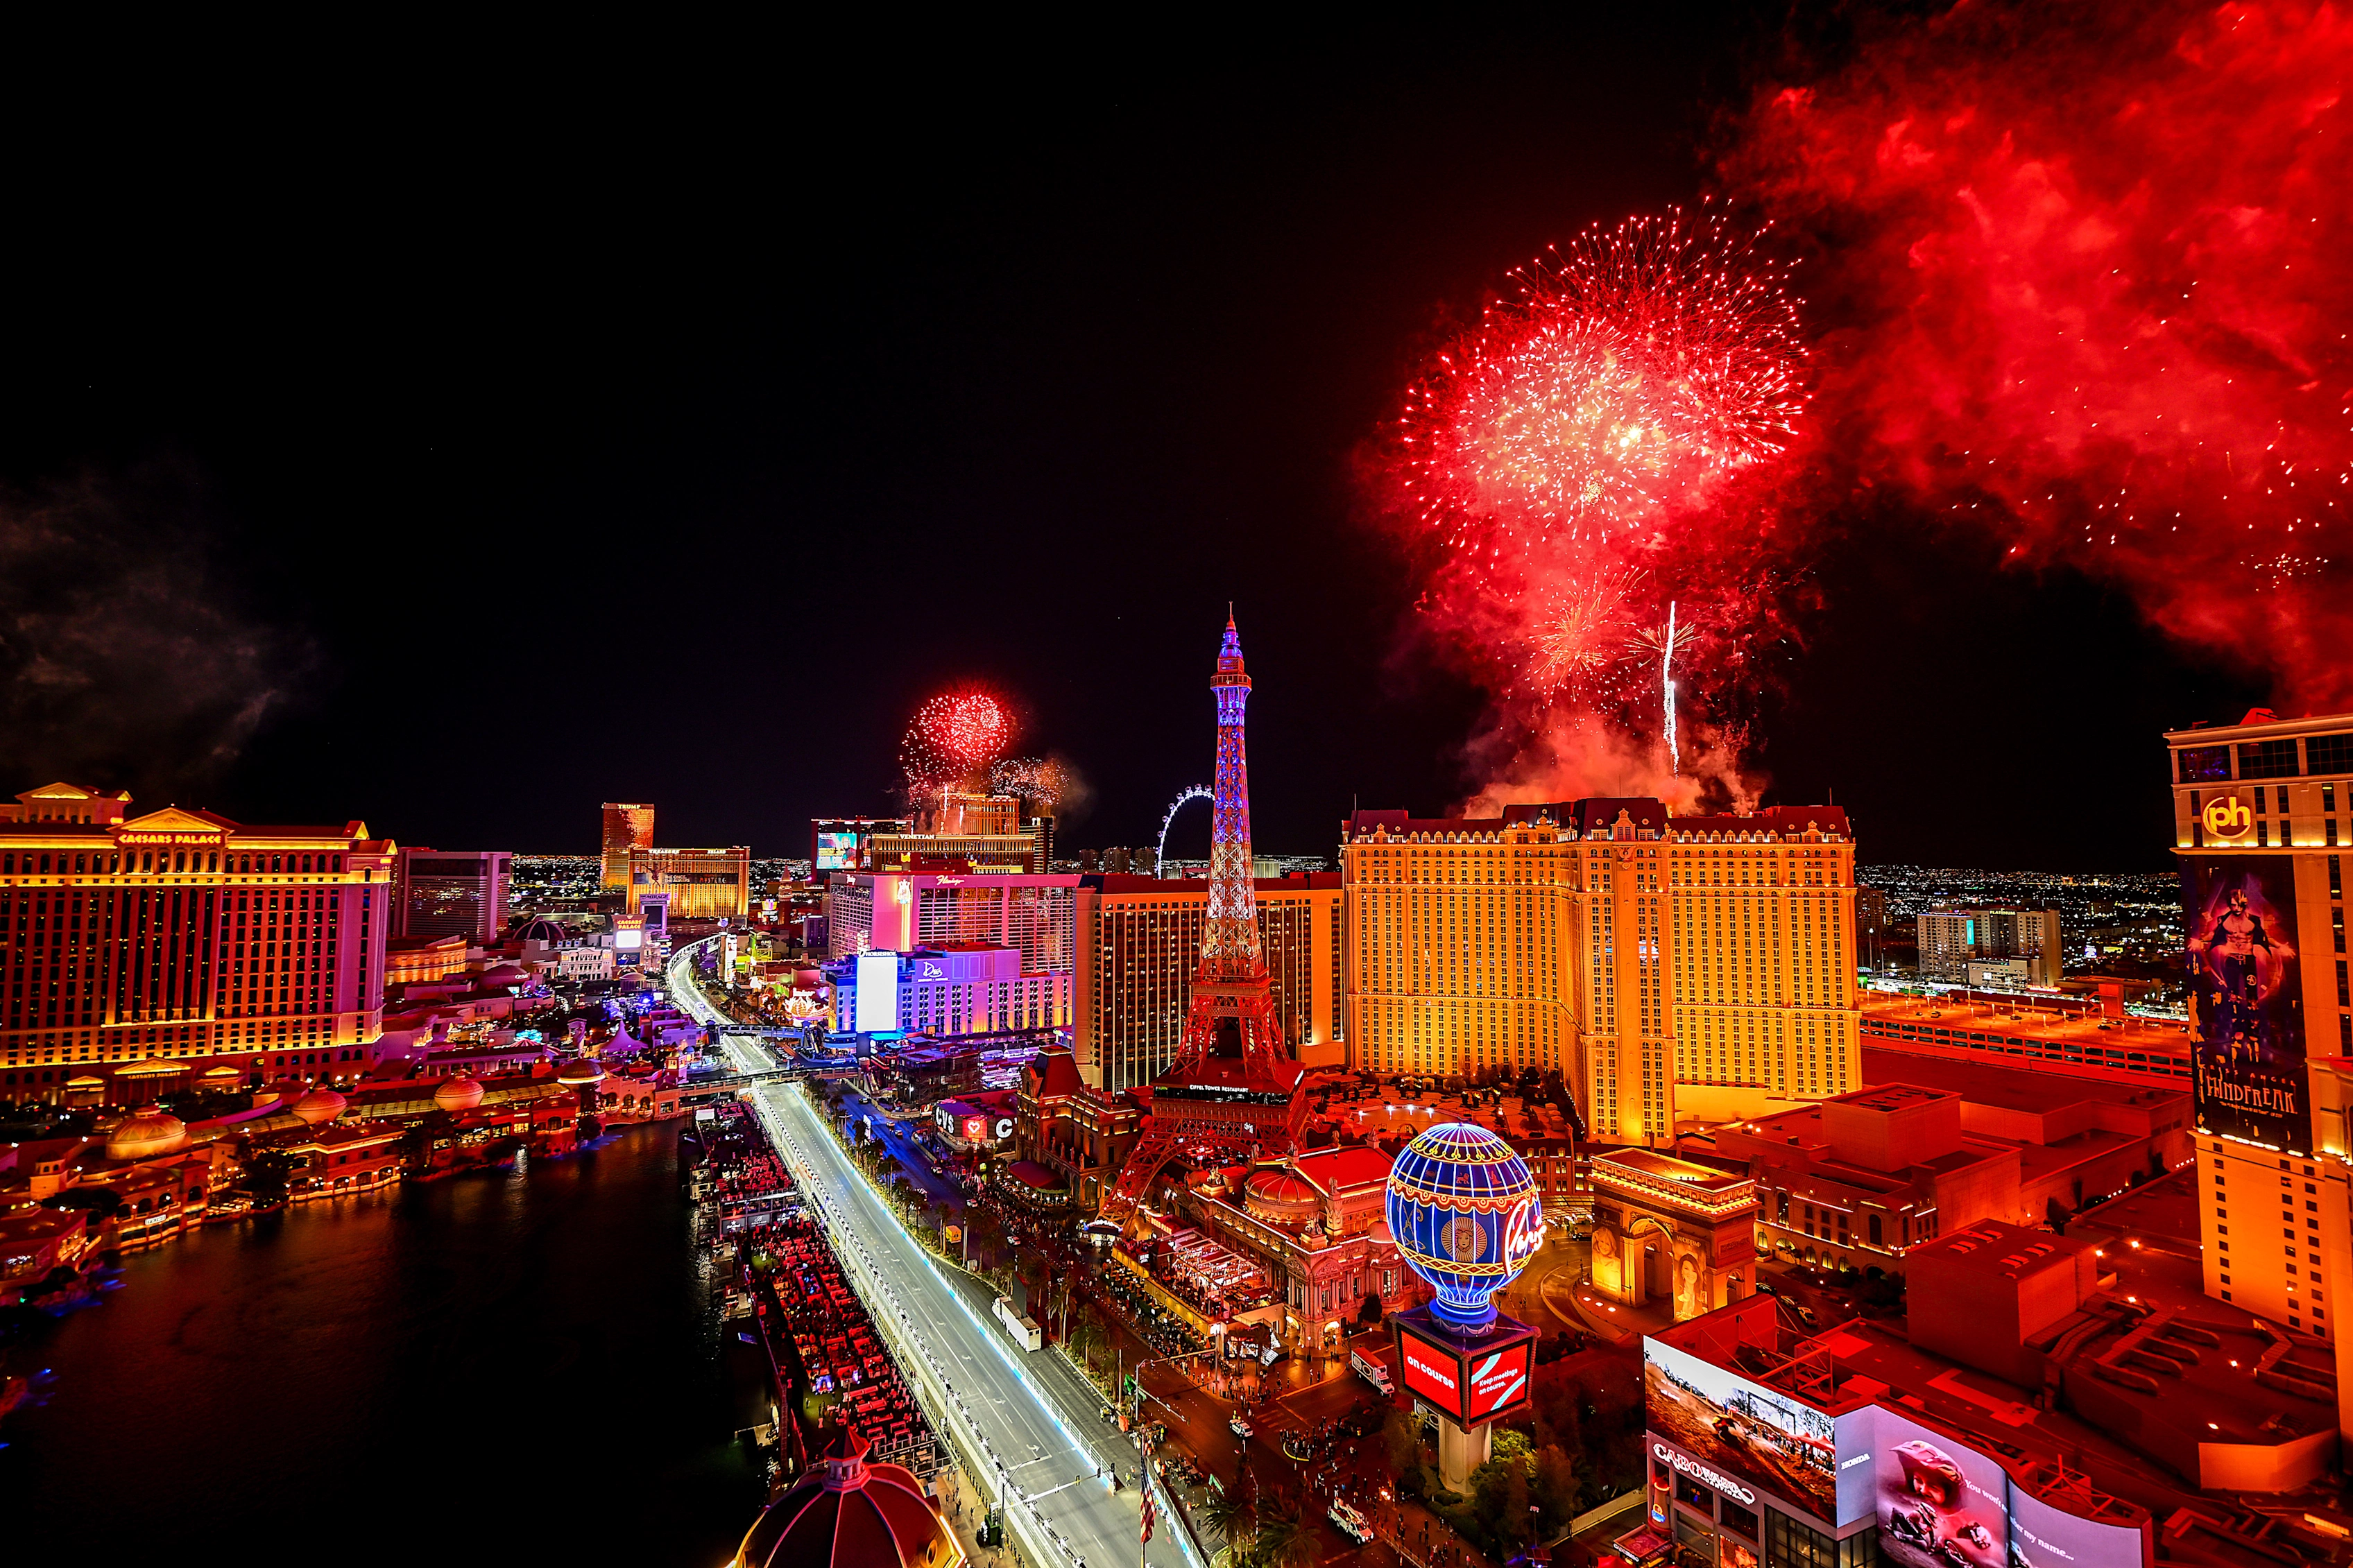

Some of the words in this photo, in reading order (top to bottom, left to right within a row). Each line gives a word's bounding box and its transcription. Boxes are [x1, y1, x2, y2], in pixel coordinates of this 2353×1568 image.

[2209, 797, 2251, 832] ph
[119, 834, 173, 843] CAESARS
[175, 835, 221, 844] PALACE
[2250, 1072, 2296, 1087] ANGEL
[2207, 1076, 2296, 1114] MINDFREAK
[936, 1106, 955, 1134] CVS
[1152, 1217, 1161, 1229] BEER
[1161, 1223, 1172, 1235] PARK
[1504, 1198, 1547, 1277] Paris
[1407, 1356, 1420, 1370] on
[1421, 1363, 1455, 1389] course
[1479, 1377, 1494, 1387] Keep
[1493, 1368, 1518, 1381] meetings
[1487, 1381, 1506, 1392] course.
[1653, 1443, 1702, 1478] CABO
[1840, 1453, 1871, 1470] HONDA
[1704, 1477, 1740, 1500] CANTINA
[1965, 1479, 1981, 1494] You
[1982, 1490, 2001, 1508] won't
[2023, 1529, 2037, 1544] my
[2037, 1538, 2075, 1561] name...
